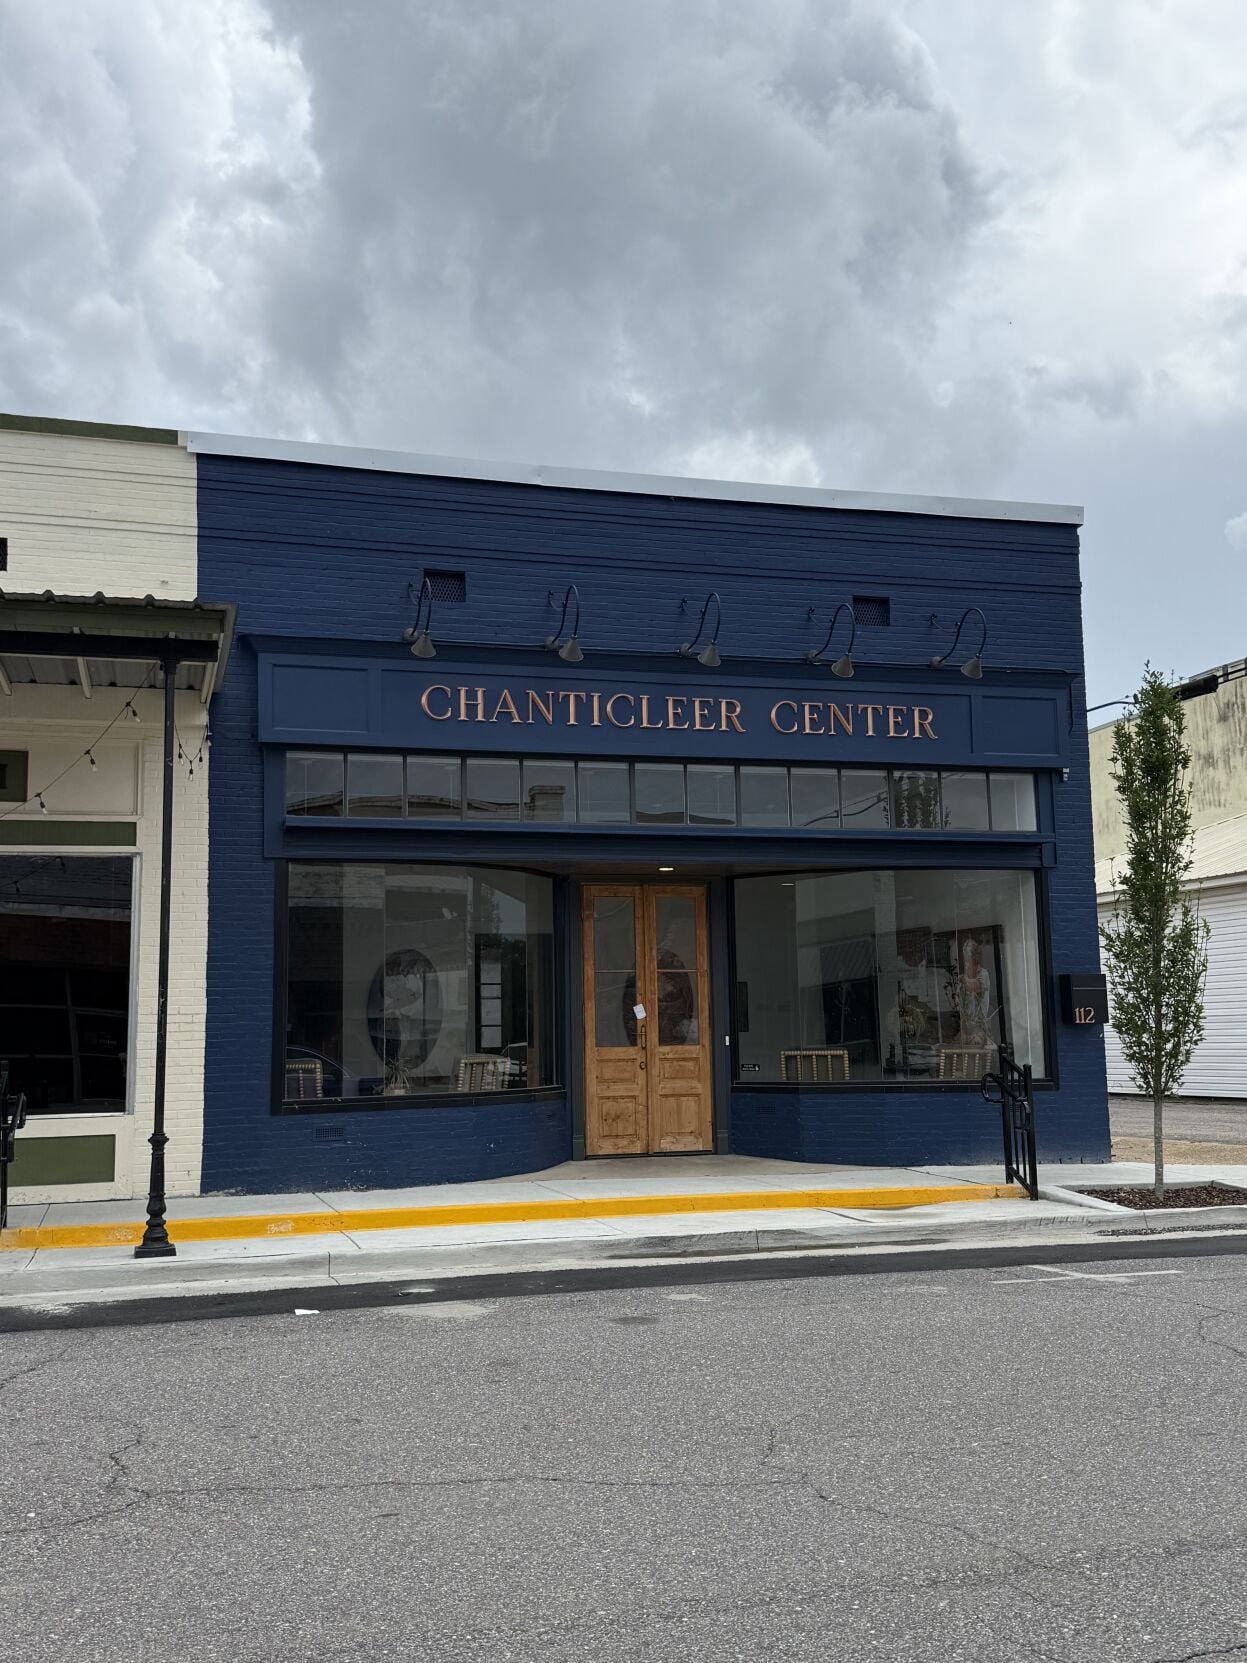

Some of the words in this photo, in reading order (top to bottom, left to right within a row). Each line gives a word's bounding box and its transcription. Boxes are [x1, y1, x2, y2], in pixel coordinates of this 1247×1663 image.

[420, 684, 747, 733] CHANTICLEER
[769, 699, 938, 740] CENTER
[1075, 1007, 1095, 1024] 112
